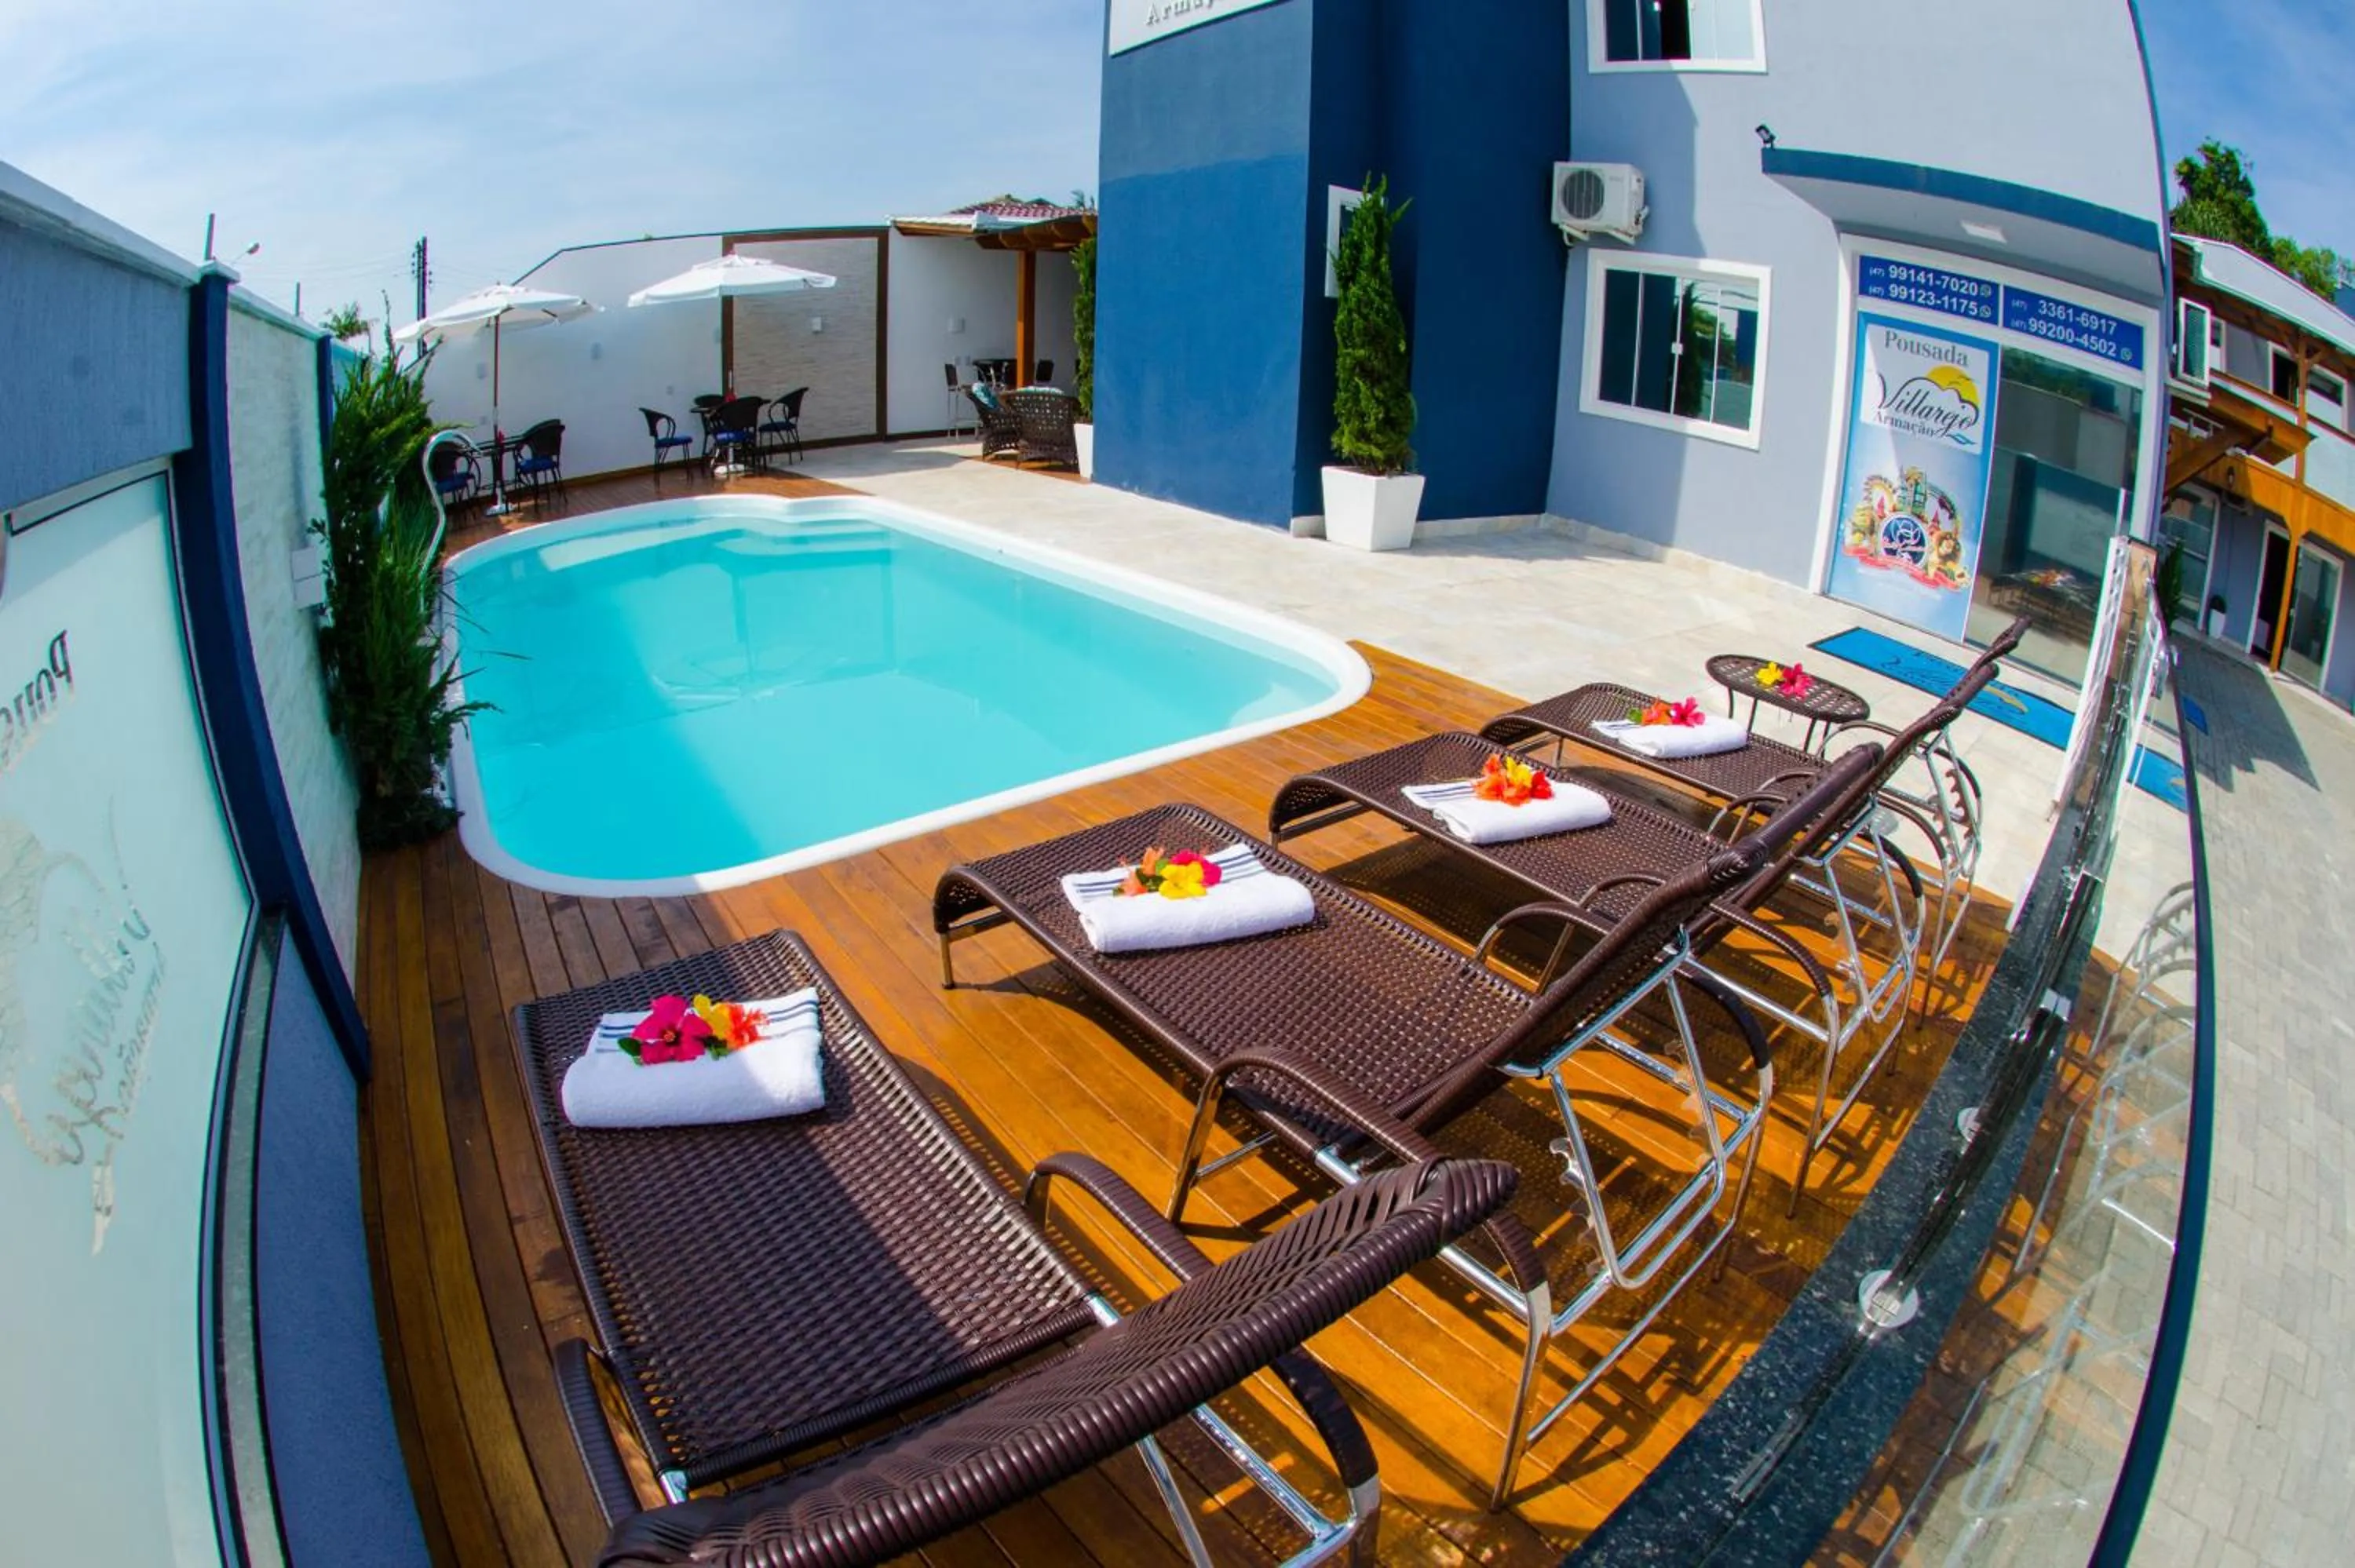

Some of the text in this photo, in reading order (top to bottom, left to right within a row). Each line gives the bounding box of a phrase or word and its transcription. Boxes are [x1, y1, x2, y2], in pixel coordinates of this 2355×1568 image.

[1145, 0, 1214, 25] Arma
[1869, 264, 1978, 297] (47) 99141-7020
[1888, 283, 1978, 315] 99123-1175
[2037, 300, 2118, 335] 3361-6917
[1885, 330, 1969, 366] Pousada
[2028, 317, 2117, 357] 99200-4502
[1877, 371, 1980, 439] Villarejo
[1874, 410, 1937, 438] Armação
